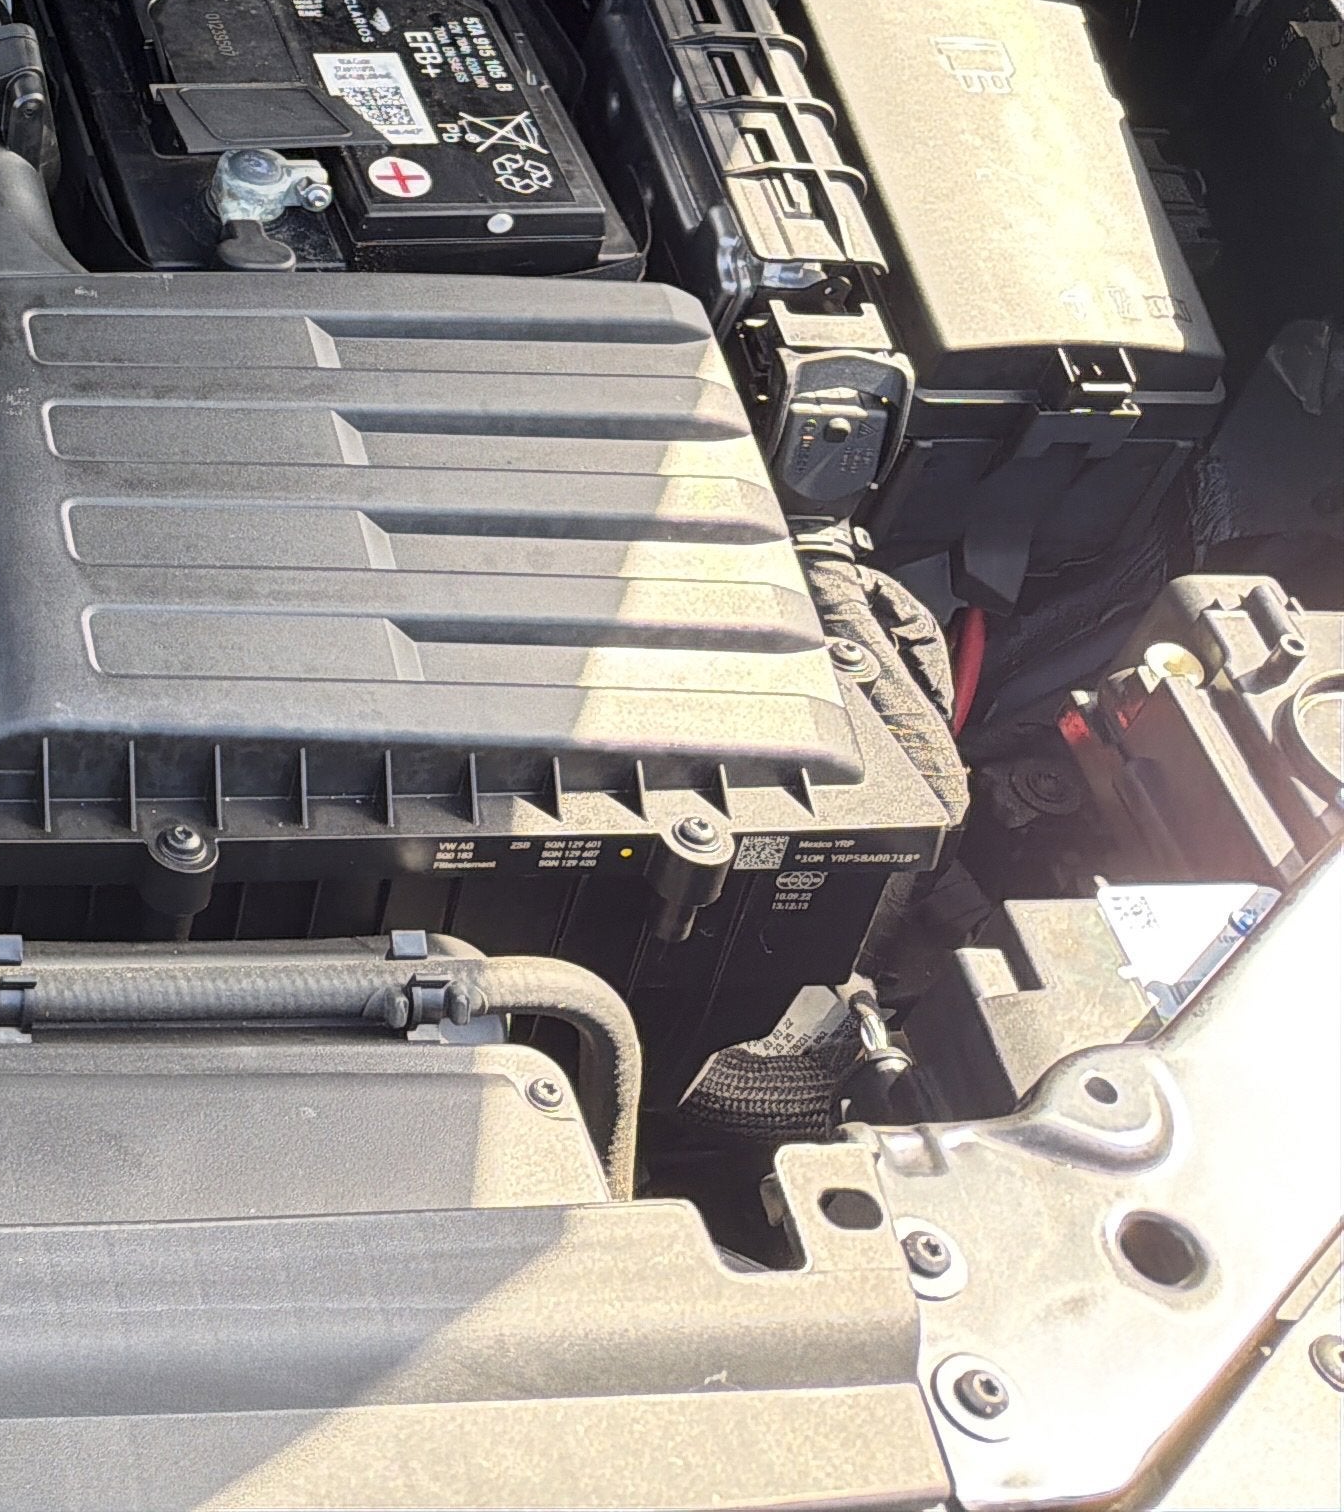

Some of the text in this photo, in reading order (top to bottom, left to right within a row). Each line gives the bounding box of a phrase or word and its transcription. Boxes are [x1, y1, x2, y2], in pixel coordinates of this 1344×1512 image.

[472, 37, 496, 57] 915
[403, 31, 444, 78] EFB+
[483, 59, 508, 78] 105
[437, 123, 463, 143] Pb
[439, 842, 474, 850] VW AG
[567, 841, 584, 849] 129
[585, 841, 602, 849] 601
[799, 840, 856, 849] Mexico YRP
[564, 850, 581, 858] 129
